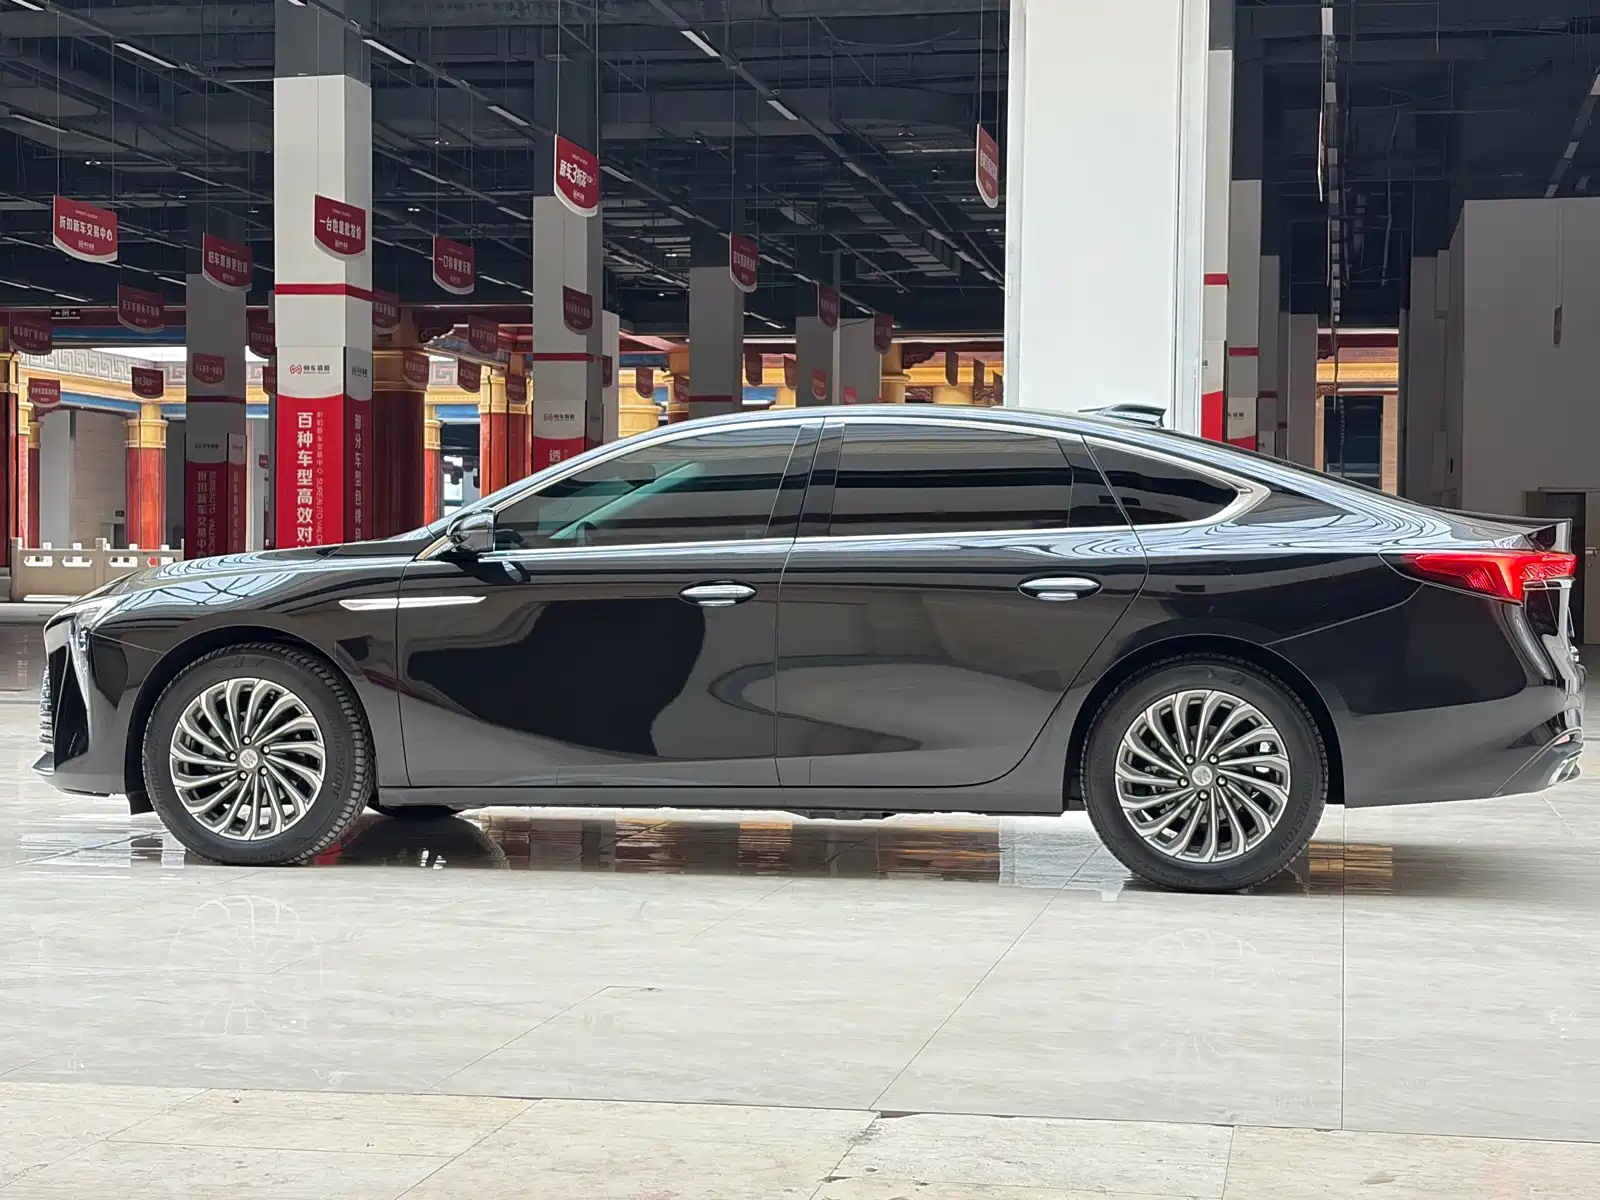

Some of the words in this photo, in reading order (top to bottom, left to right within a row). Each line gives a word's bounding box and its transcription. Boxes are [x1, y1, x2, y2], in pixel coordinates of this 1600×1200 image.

[59, 215, 113, 242] 折扣新车交易中心
[319, 216, 362, 240] 一台也是批发价
[549, 449, 561, 467] 透
[297, 411, 313, 547] 百种车型高效对
